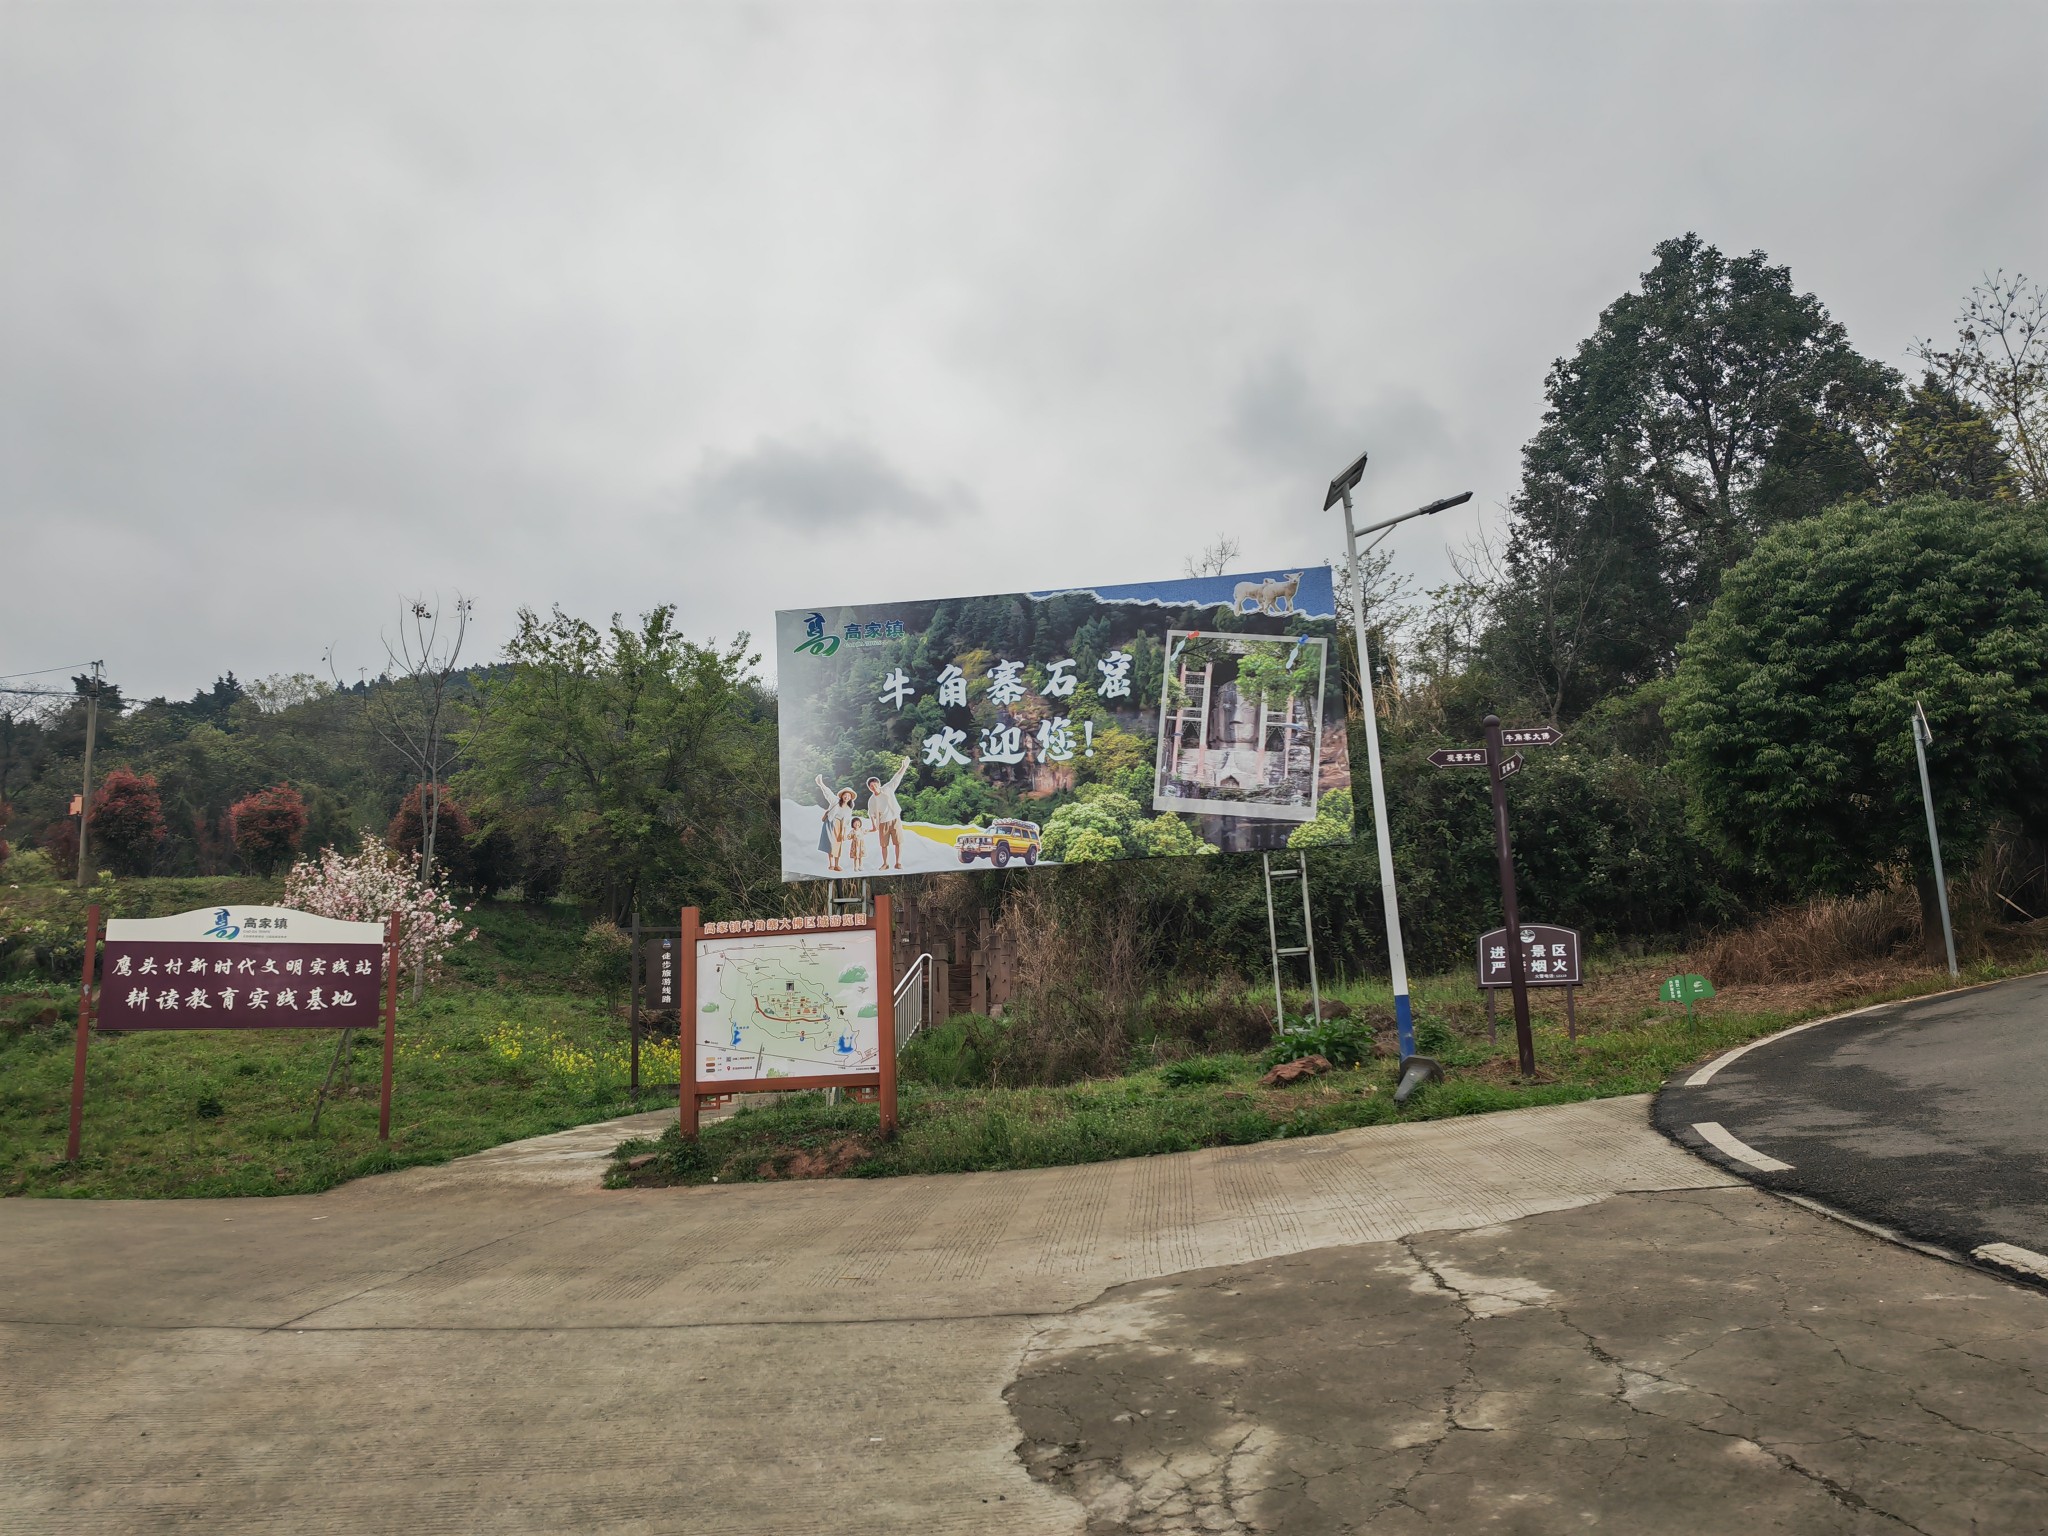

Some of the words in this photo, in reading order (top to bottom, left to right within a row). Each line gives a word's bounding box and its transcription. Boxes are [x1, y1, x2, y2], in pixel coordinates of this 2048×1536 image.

[843, 620, 905, 641] 高家镇
[878, 650, 1133, 711] 牛角寨石窟
[922, 716, 1094, 767] 欢迎您!
[1505, 732, 1551, 743] 牛角寨大佛
[1446, 752, 1482, 762] 观景平台
[243, 917, 289, 930] 高家镇
[704, 912, 867, 935] 高家镇牛角寨大佛区域游览图
[111, 954, 373, 977] 鹰头村新时代文明实践站
[661, 952, 672, 1004] 徒步旅游线路
[125, 986, 358, 1012] 耕读教育实践基地
